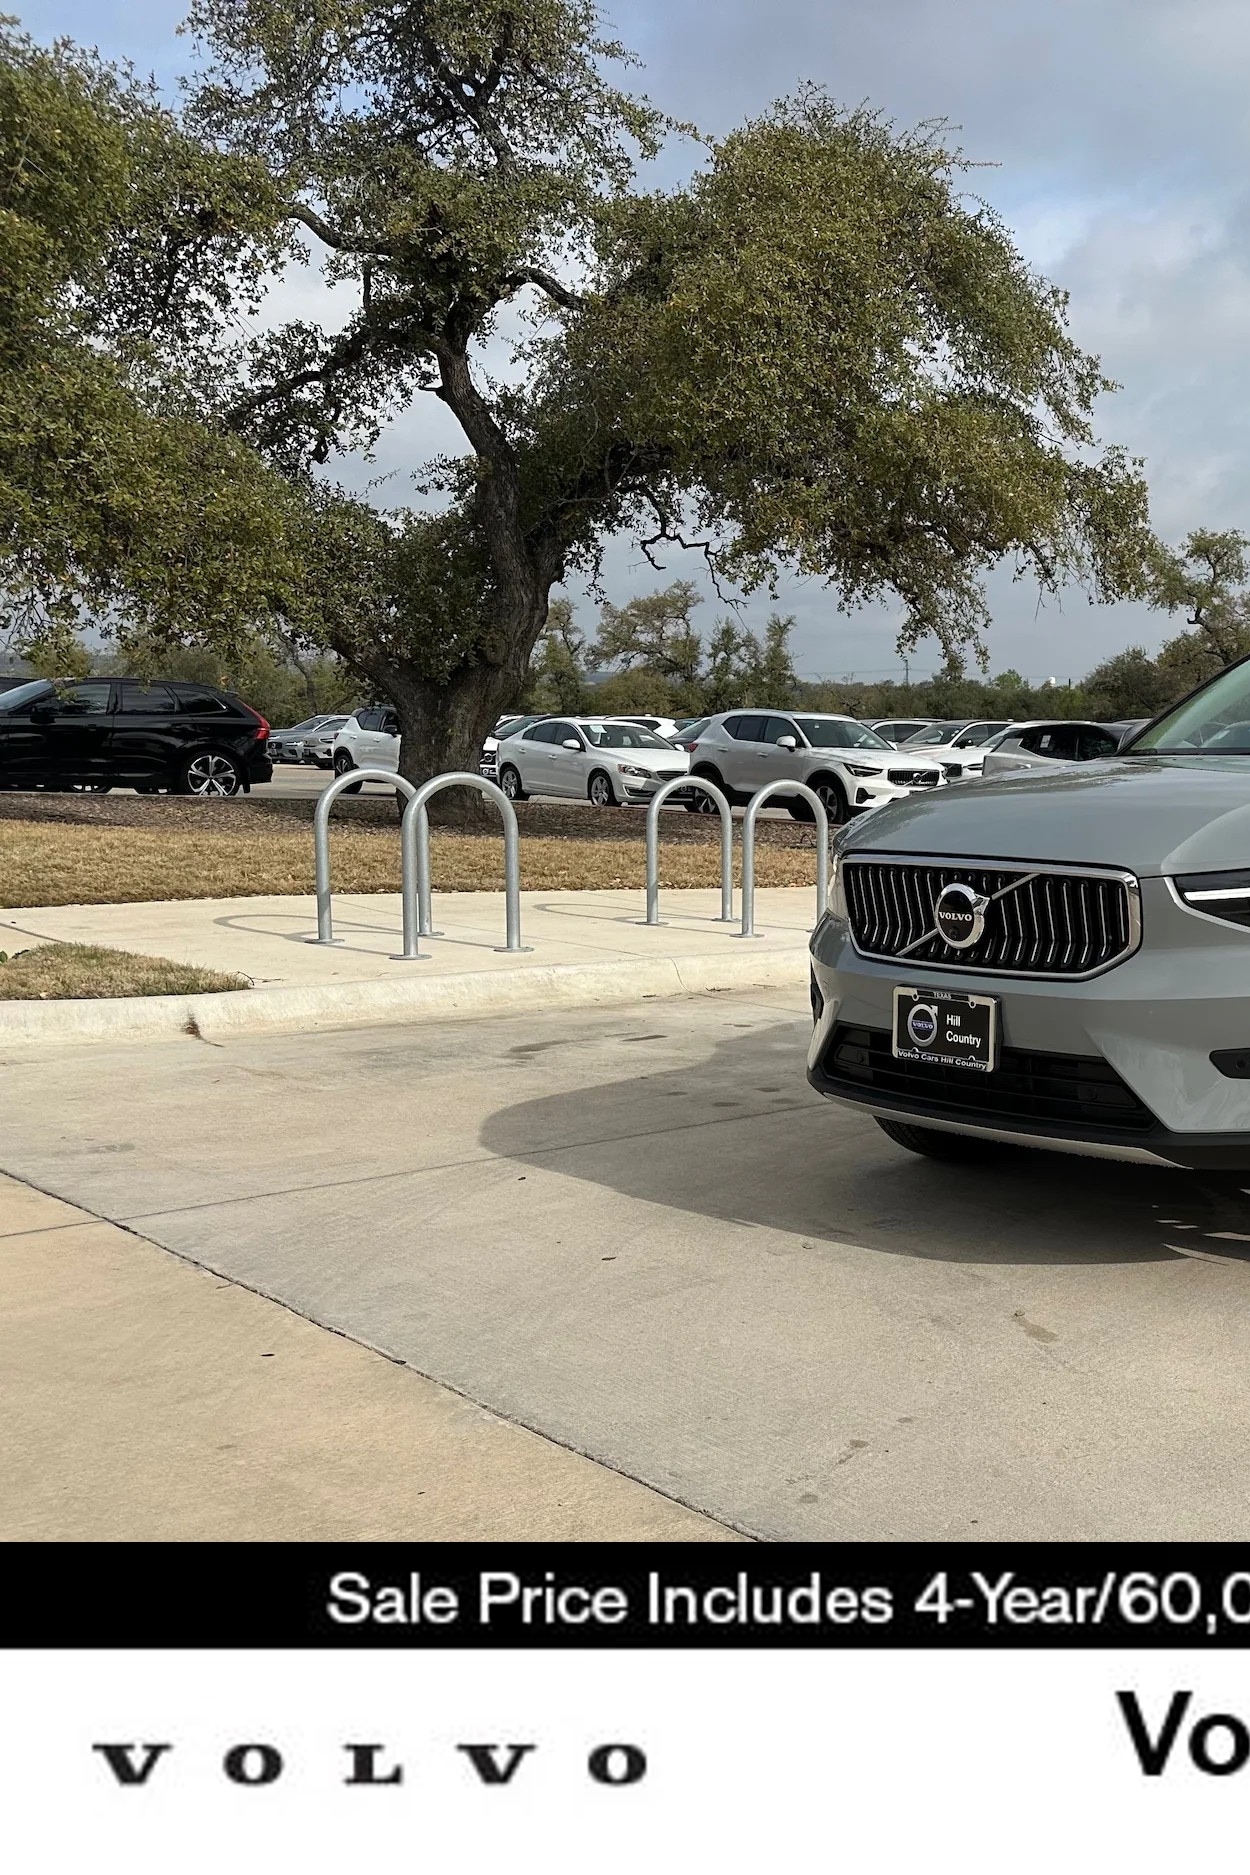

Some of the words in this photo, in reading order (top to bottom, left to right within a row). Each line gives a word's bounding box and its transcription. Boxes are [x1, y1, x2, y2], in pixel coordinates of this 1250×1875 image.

[939, 912, 972, 921] VOLVO
[933, 991, 952, 1000] TEXAS
[912, 1021, 934, 1030] VOLVO
[946, 1014, 961, 1027] Hill
[946, 1030, 982, 1048] Country
[898, 1050, 919, 1059] Volvo
[921, 1053, 939, 1062] Cars
[941, 1056, 954, 1064] Hill
[955, 1058, 987, 1070] Country
